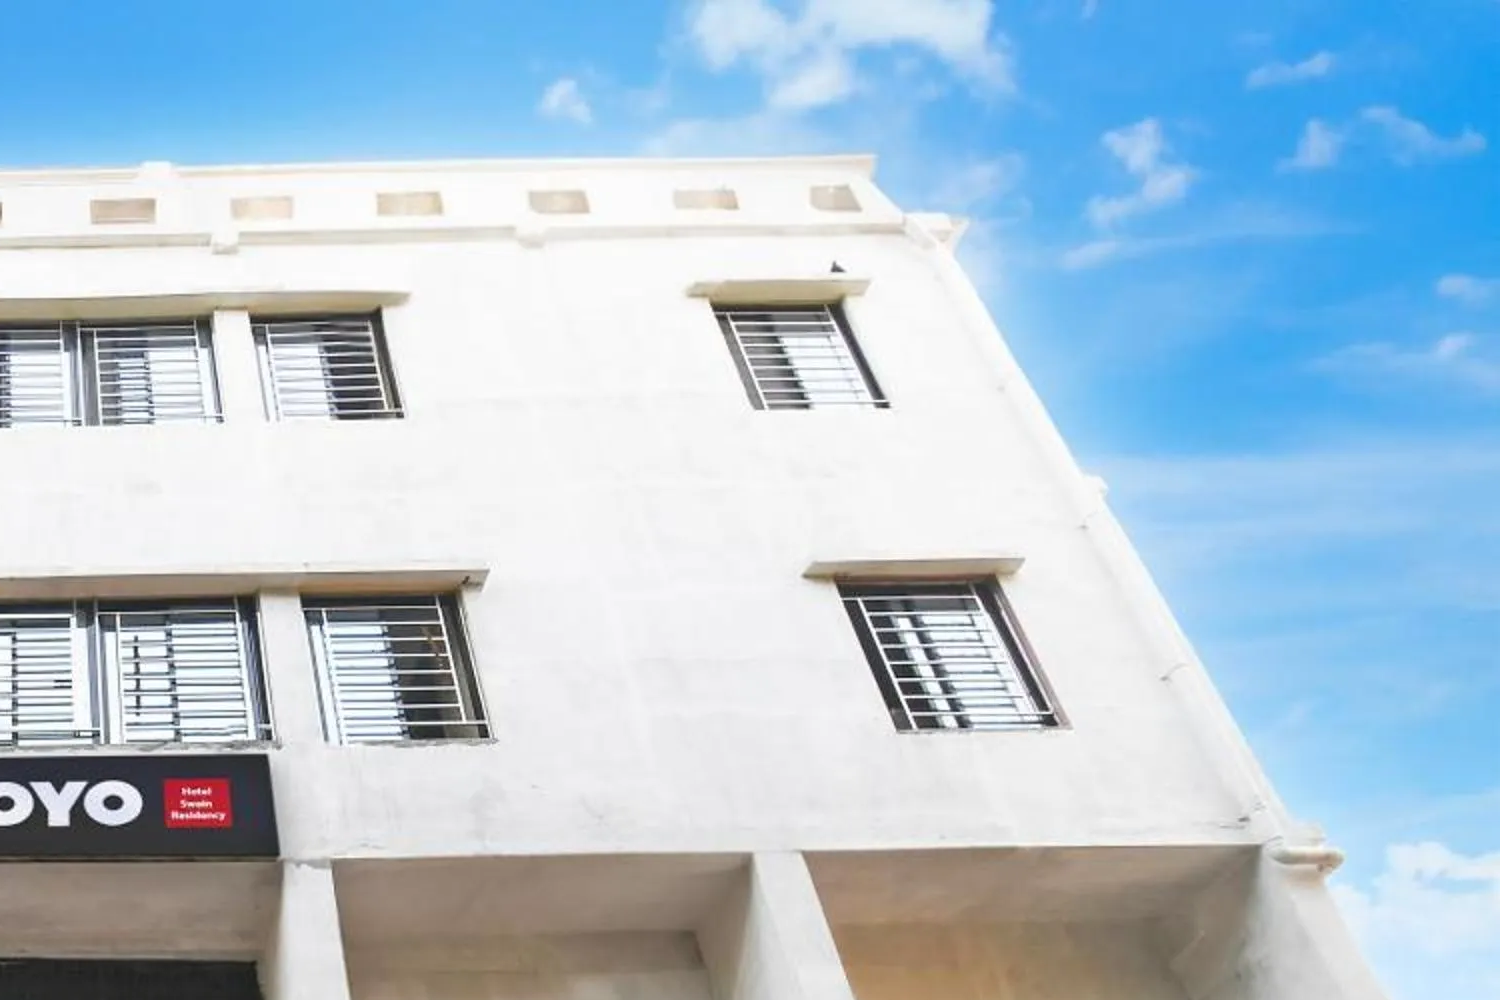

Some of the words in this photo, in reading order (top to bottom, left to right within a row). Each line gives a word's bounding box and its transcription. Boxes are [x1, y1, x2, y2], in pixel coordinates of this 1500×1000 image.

[181, 786, 212, 796] Hotel
[180, 799, 213, 809] Swain
[171, 809, 226, 821] Residency
